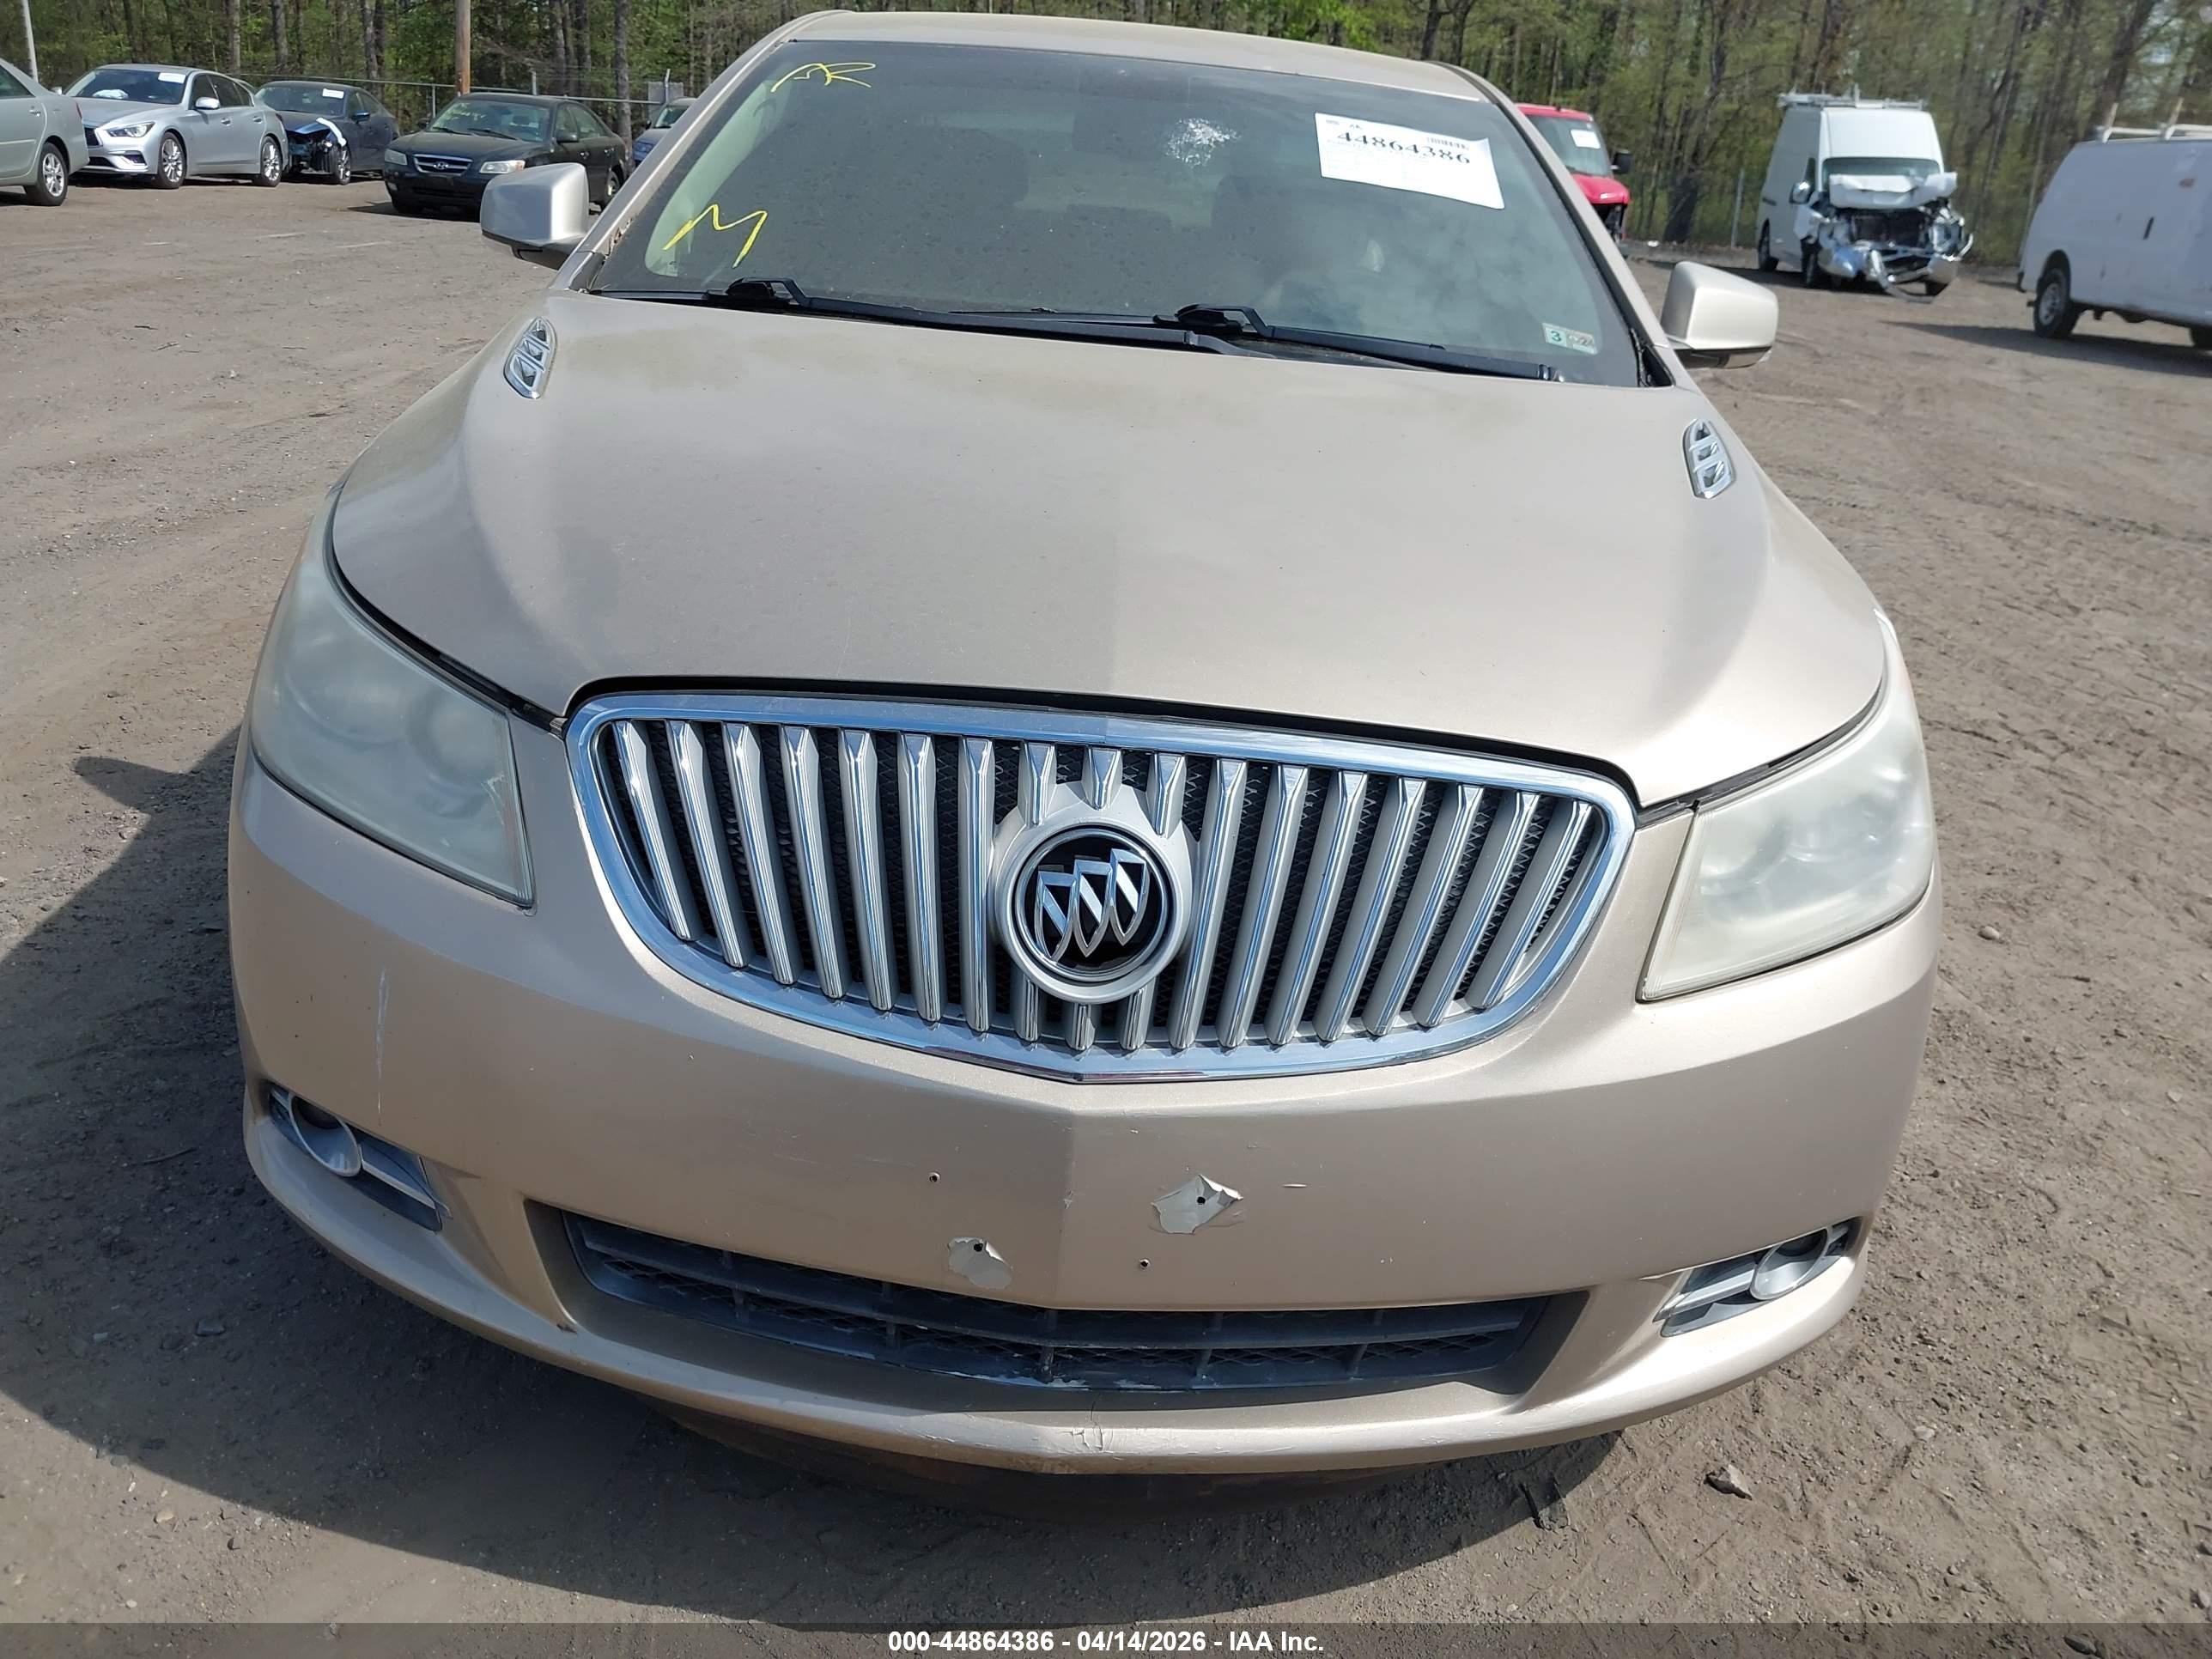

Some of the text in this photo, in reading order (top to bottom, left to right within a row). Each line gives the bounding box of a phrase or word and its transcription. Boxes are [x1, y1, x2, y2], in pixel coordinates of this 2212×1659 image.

[1337, 131, 1471, 164] 44864386
[662, 204, 769, 269] M
[1550, 330, 1562, 343] 3
